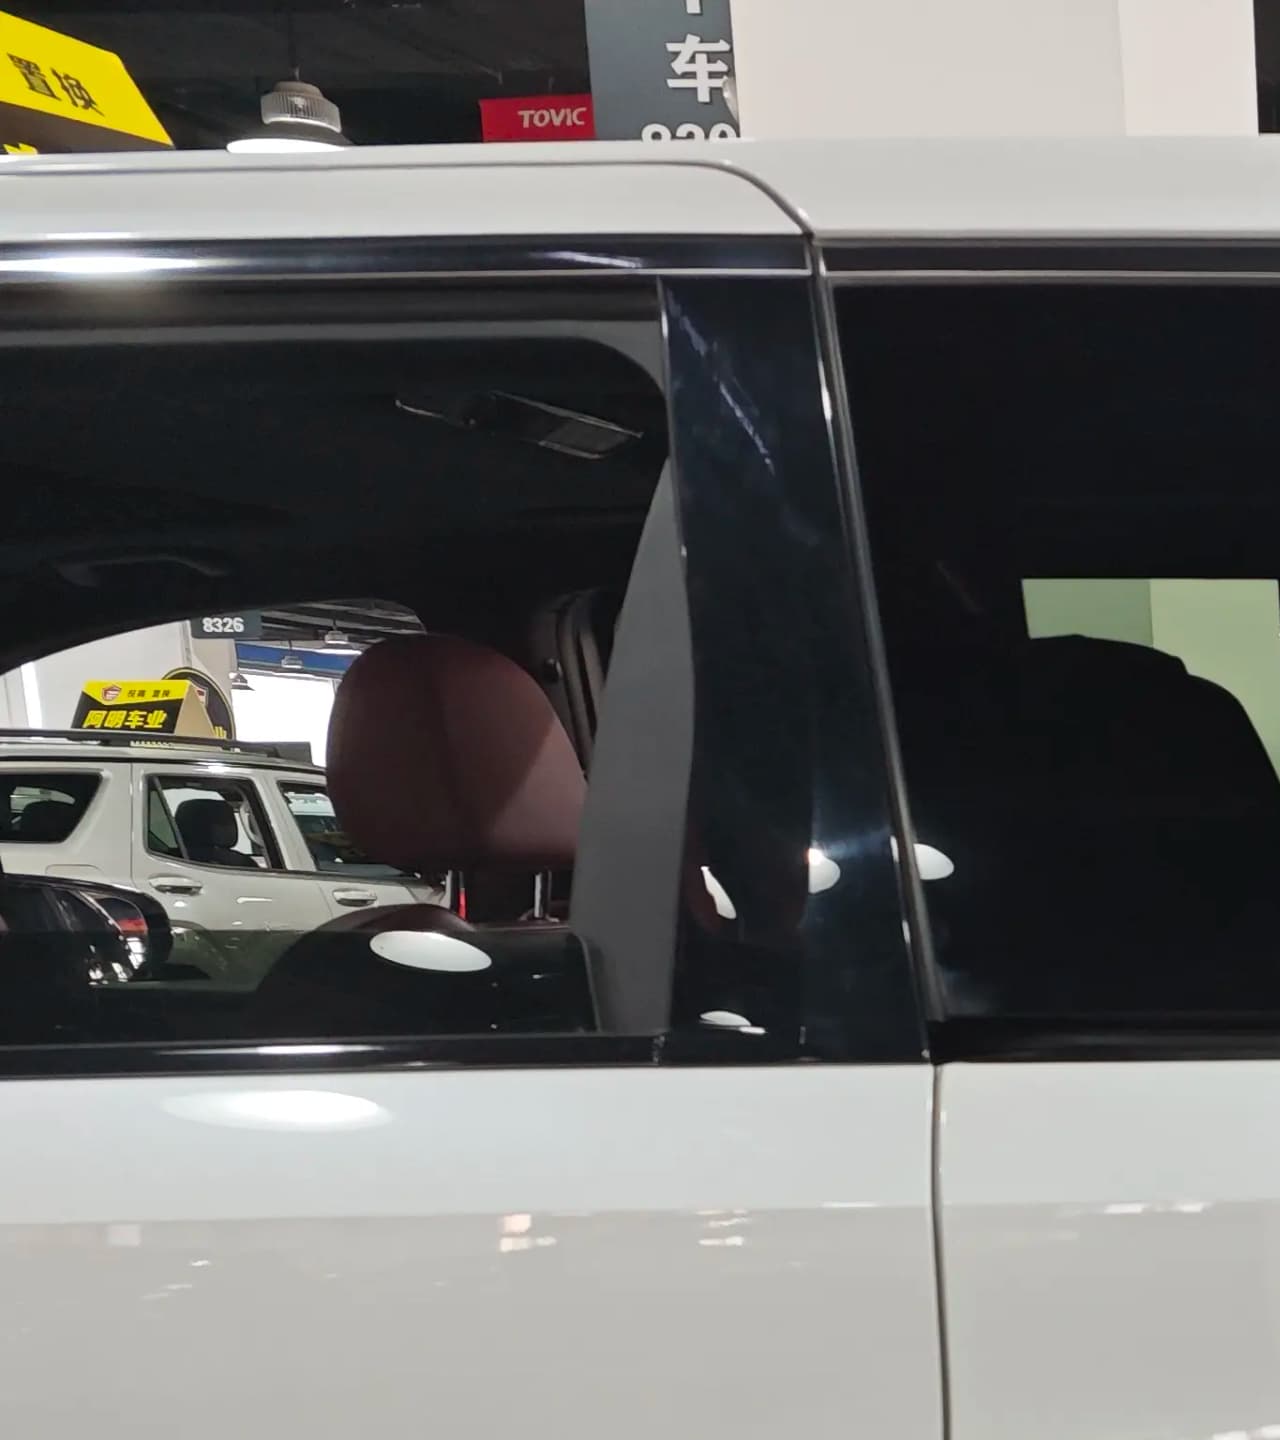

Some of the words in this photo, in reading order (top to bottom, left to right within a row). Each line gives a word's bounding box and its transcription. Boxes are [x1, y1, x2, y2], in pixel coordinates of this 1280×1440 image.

[7, 52, 105, 117] 置换
[518, 107, 588, 129] TOVIC
[202, 617, 245, 633] 8326
[82, 710, 167, 729] 阿明车业
